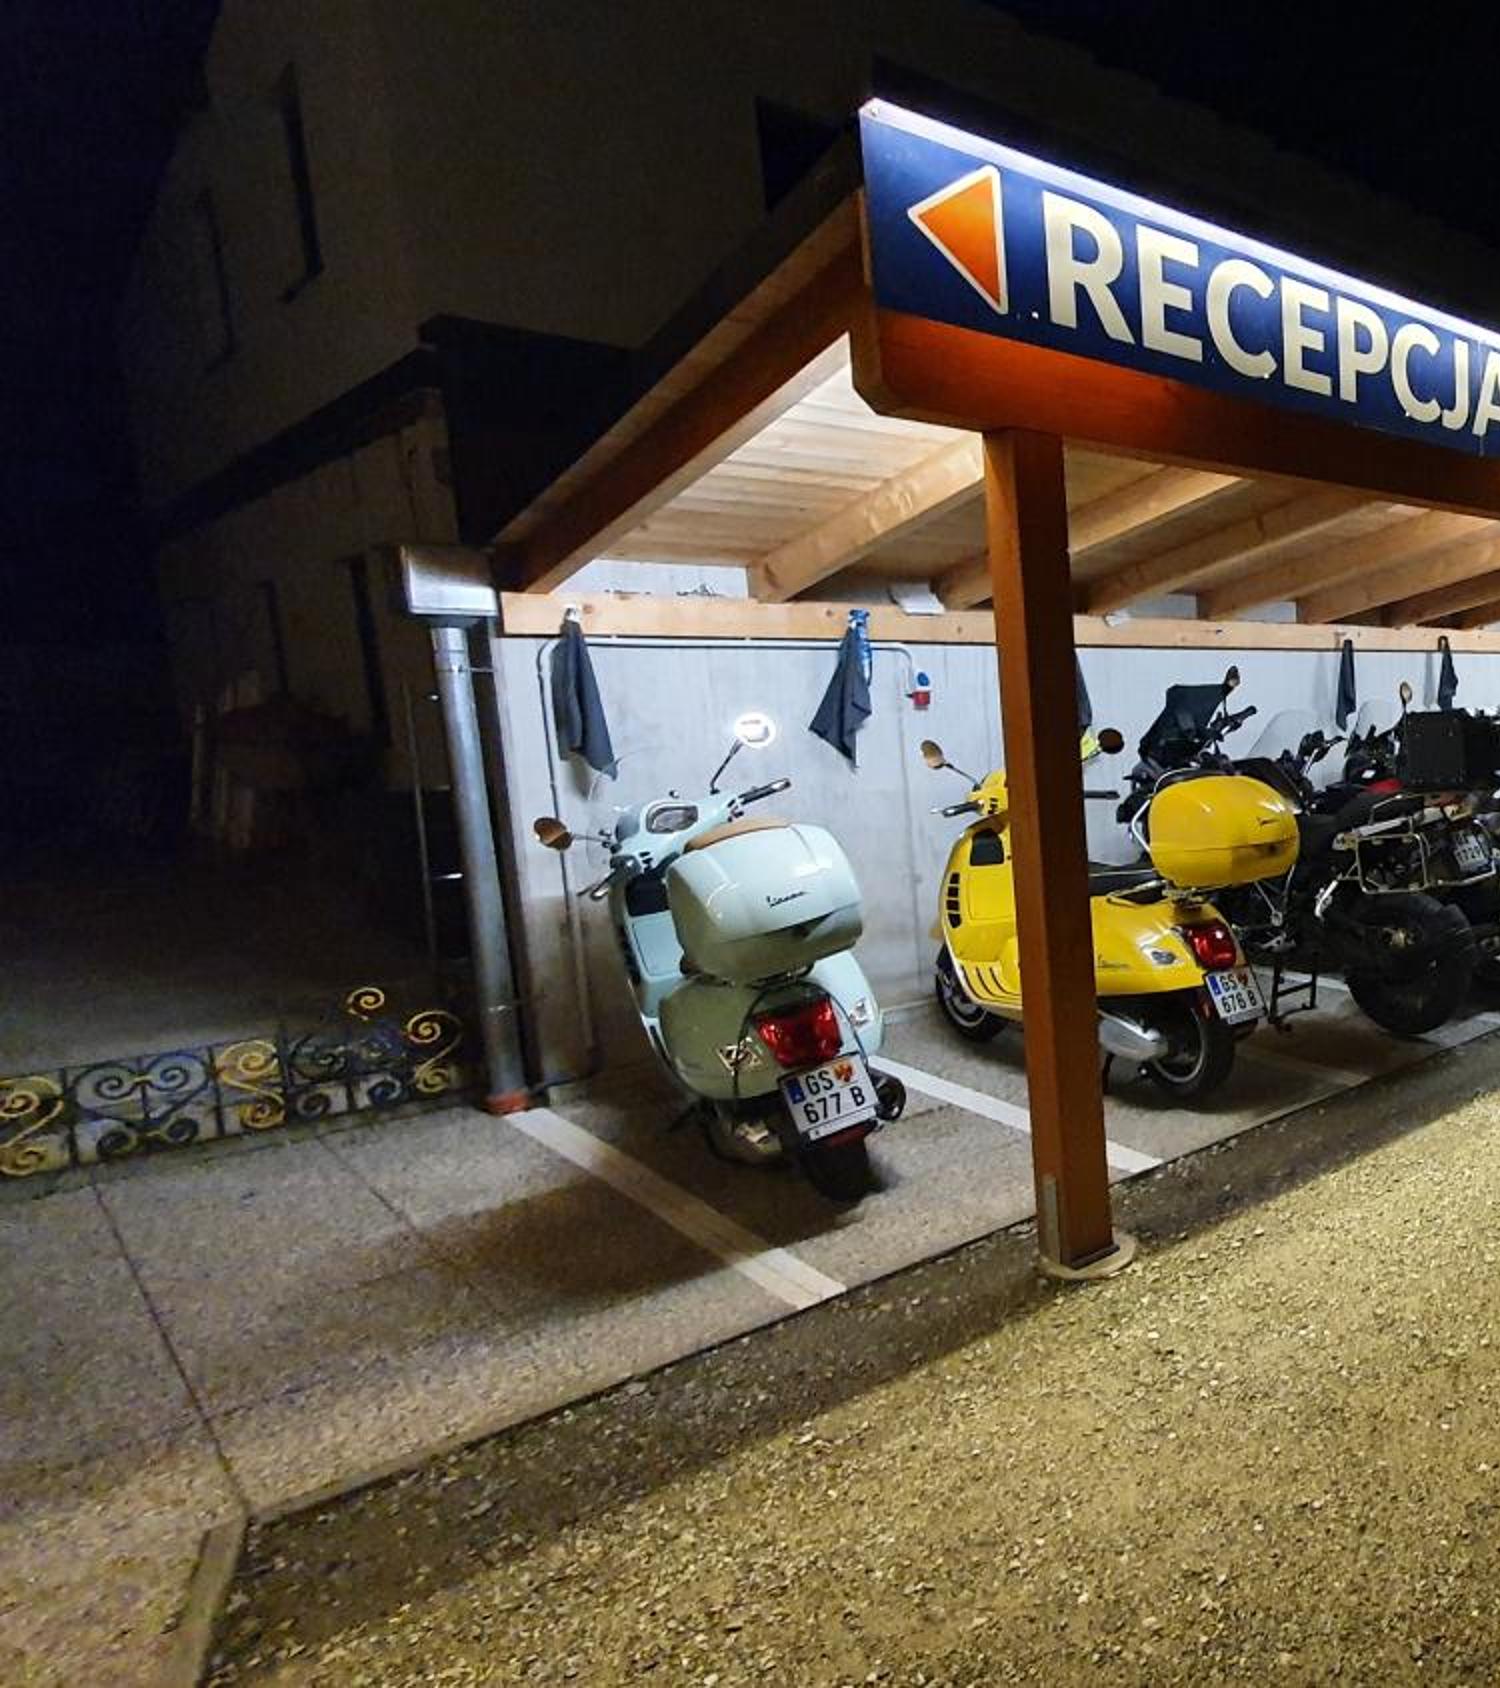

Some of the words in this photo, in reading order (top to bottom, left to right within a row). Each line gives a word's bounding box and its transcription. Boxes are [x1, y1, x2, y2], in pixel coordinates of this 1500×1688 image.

[1219, 973, 1238, 993] GS
[1221, 991, 1247, 1014] 676
[804, 1069, 835, 1096] GS
[802, 1091, 842, 1125] 677
[849, 1085, 866, 1107] B
